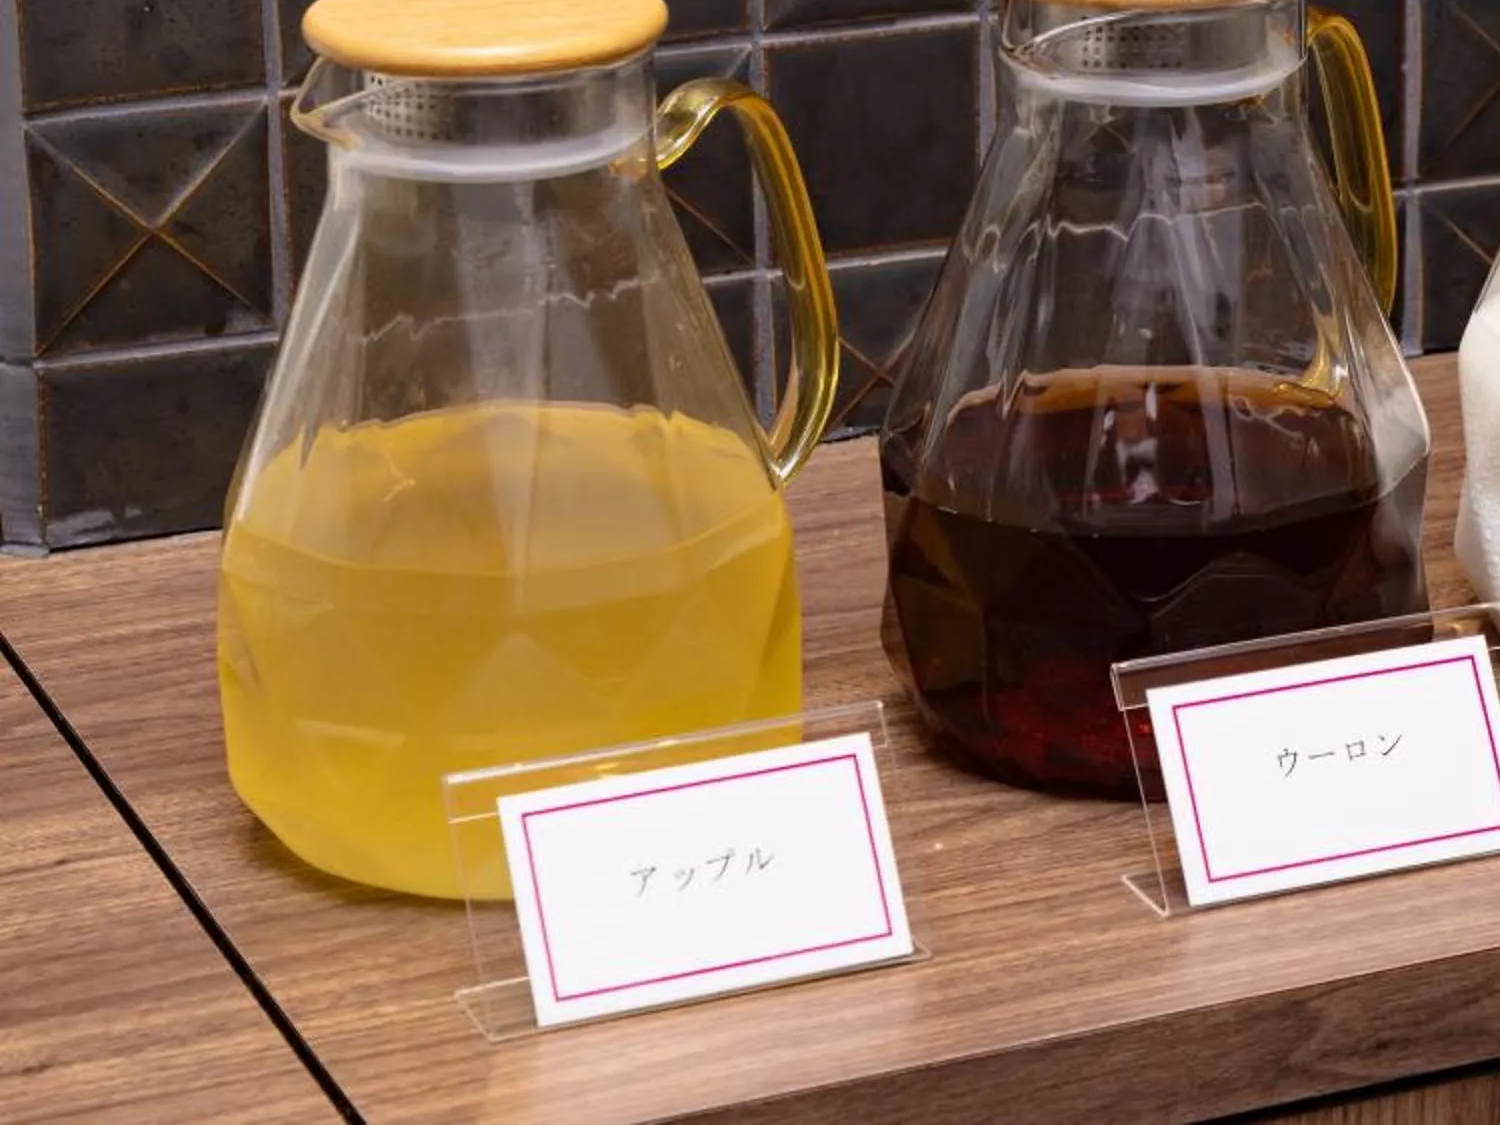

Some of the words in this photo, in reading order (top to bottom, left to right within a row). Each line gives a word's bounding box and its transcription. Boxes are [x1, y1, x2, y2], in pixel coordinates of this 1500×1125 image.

[1276, 733, 1403, 778] ウーロン
[629, 847, 774, 899] アップル
